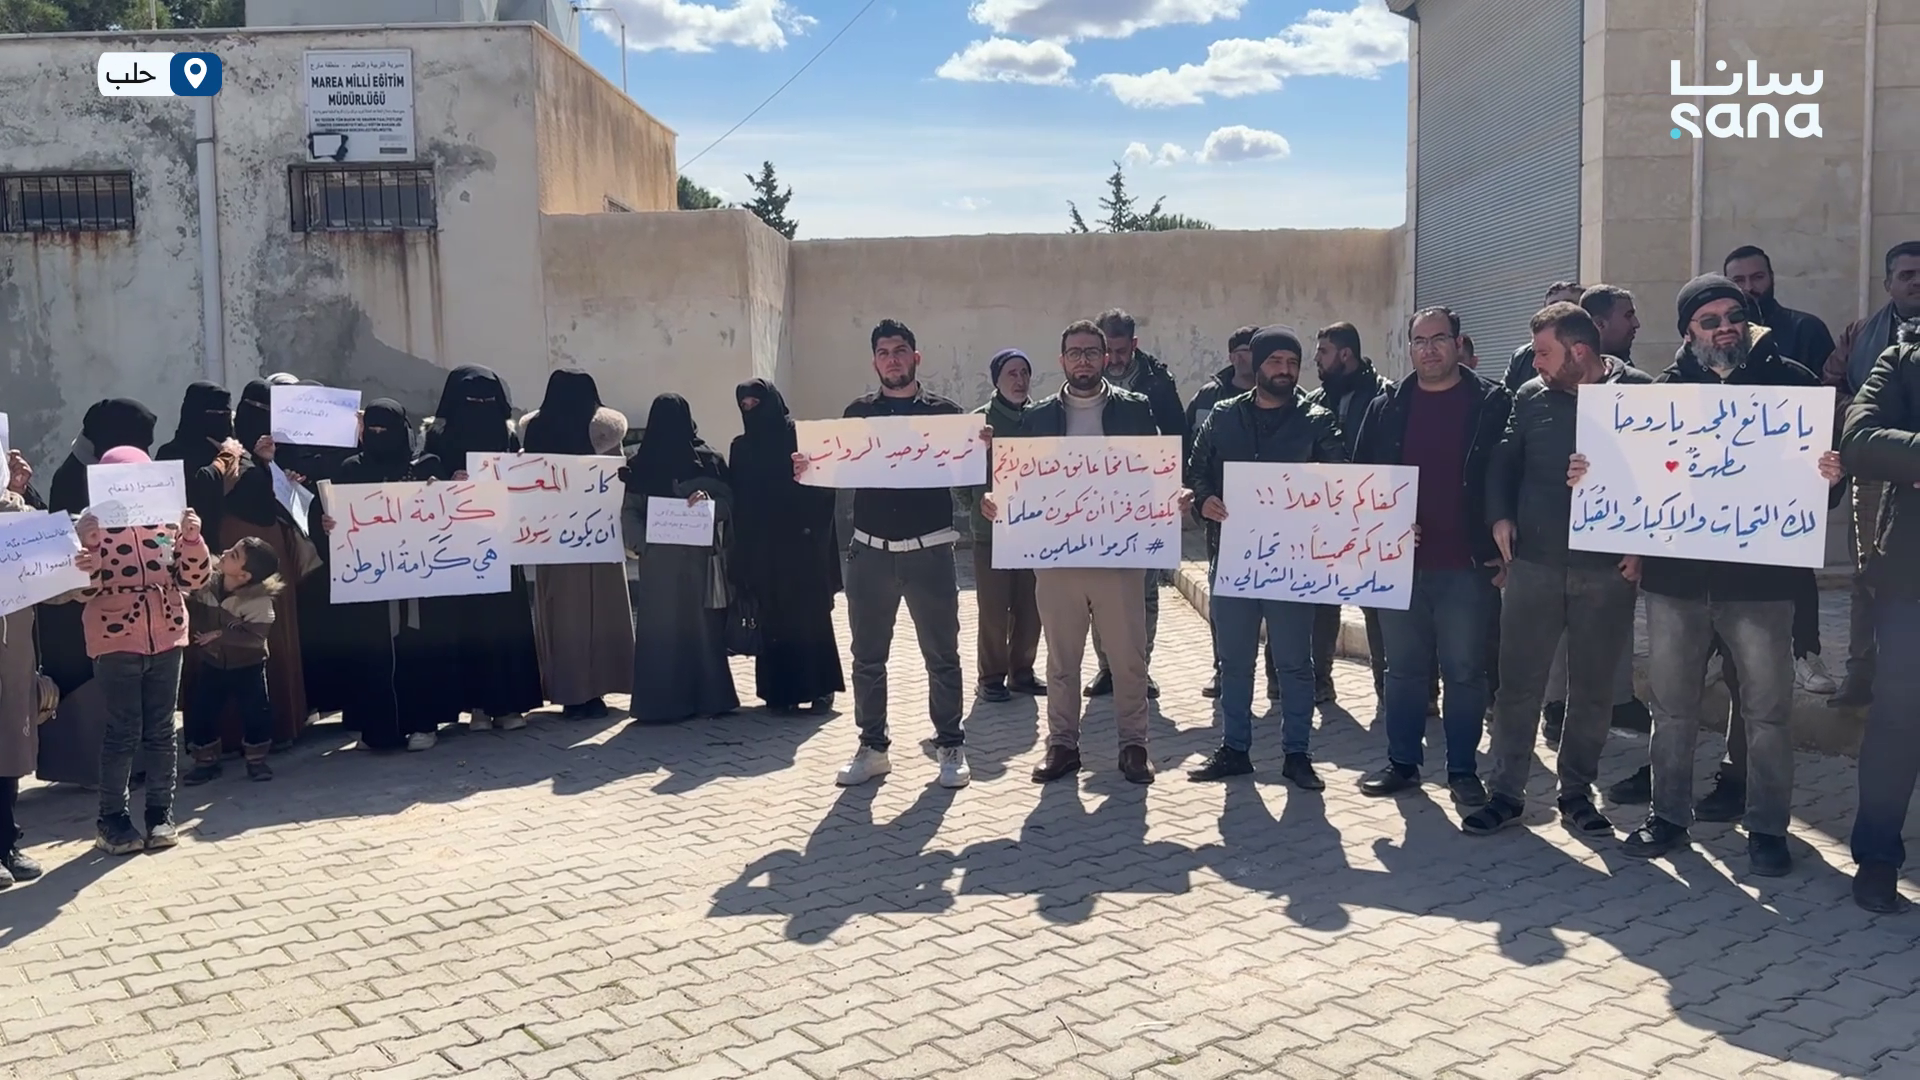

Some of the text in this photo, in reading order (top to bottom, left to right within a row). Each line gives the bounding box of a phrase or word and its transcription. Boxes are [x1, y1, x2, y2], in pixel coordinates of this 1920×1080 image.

[311, 73, 404, 88] MAREA MİLLİ EĞİTİM
[328, 91, 386, 106] MÜDÜRLÜĞÜ
[1687, 399, 1736, 440] المجد
[809, 436, 881, 470] الرواتب
[885, 433, 929, 468] توحيد
[1352, 473, 1410, 523] كفاكم
[1711, 505, 1779, 548] التحيات
[1040, 534, 1093, 561] المعلمين
[1357, 522, 1410, 570] كفاكم
[1234, 565, 1293, 592] الشمالي
[1290, 573, 1338, 597] الريف
[1337, 571, 1394, 600] معلمي
